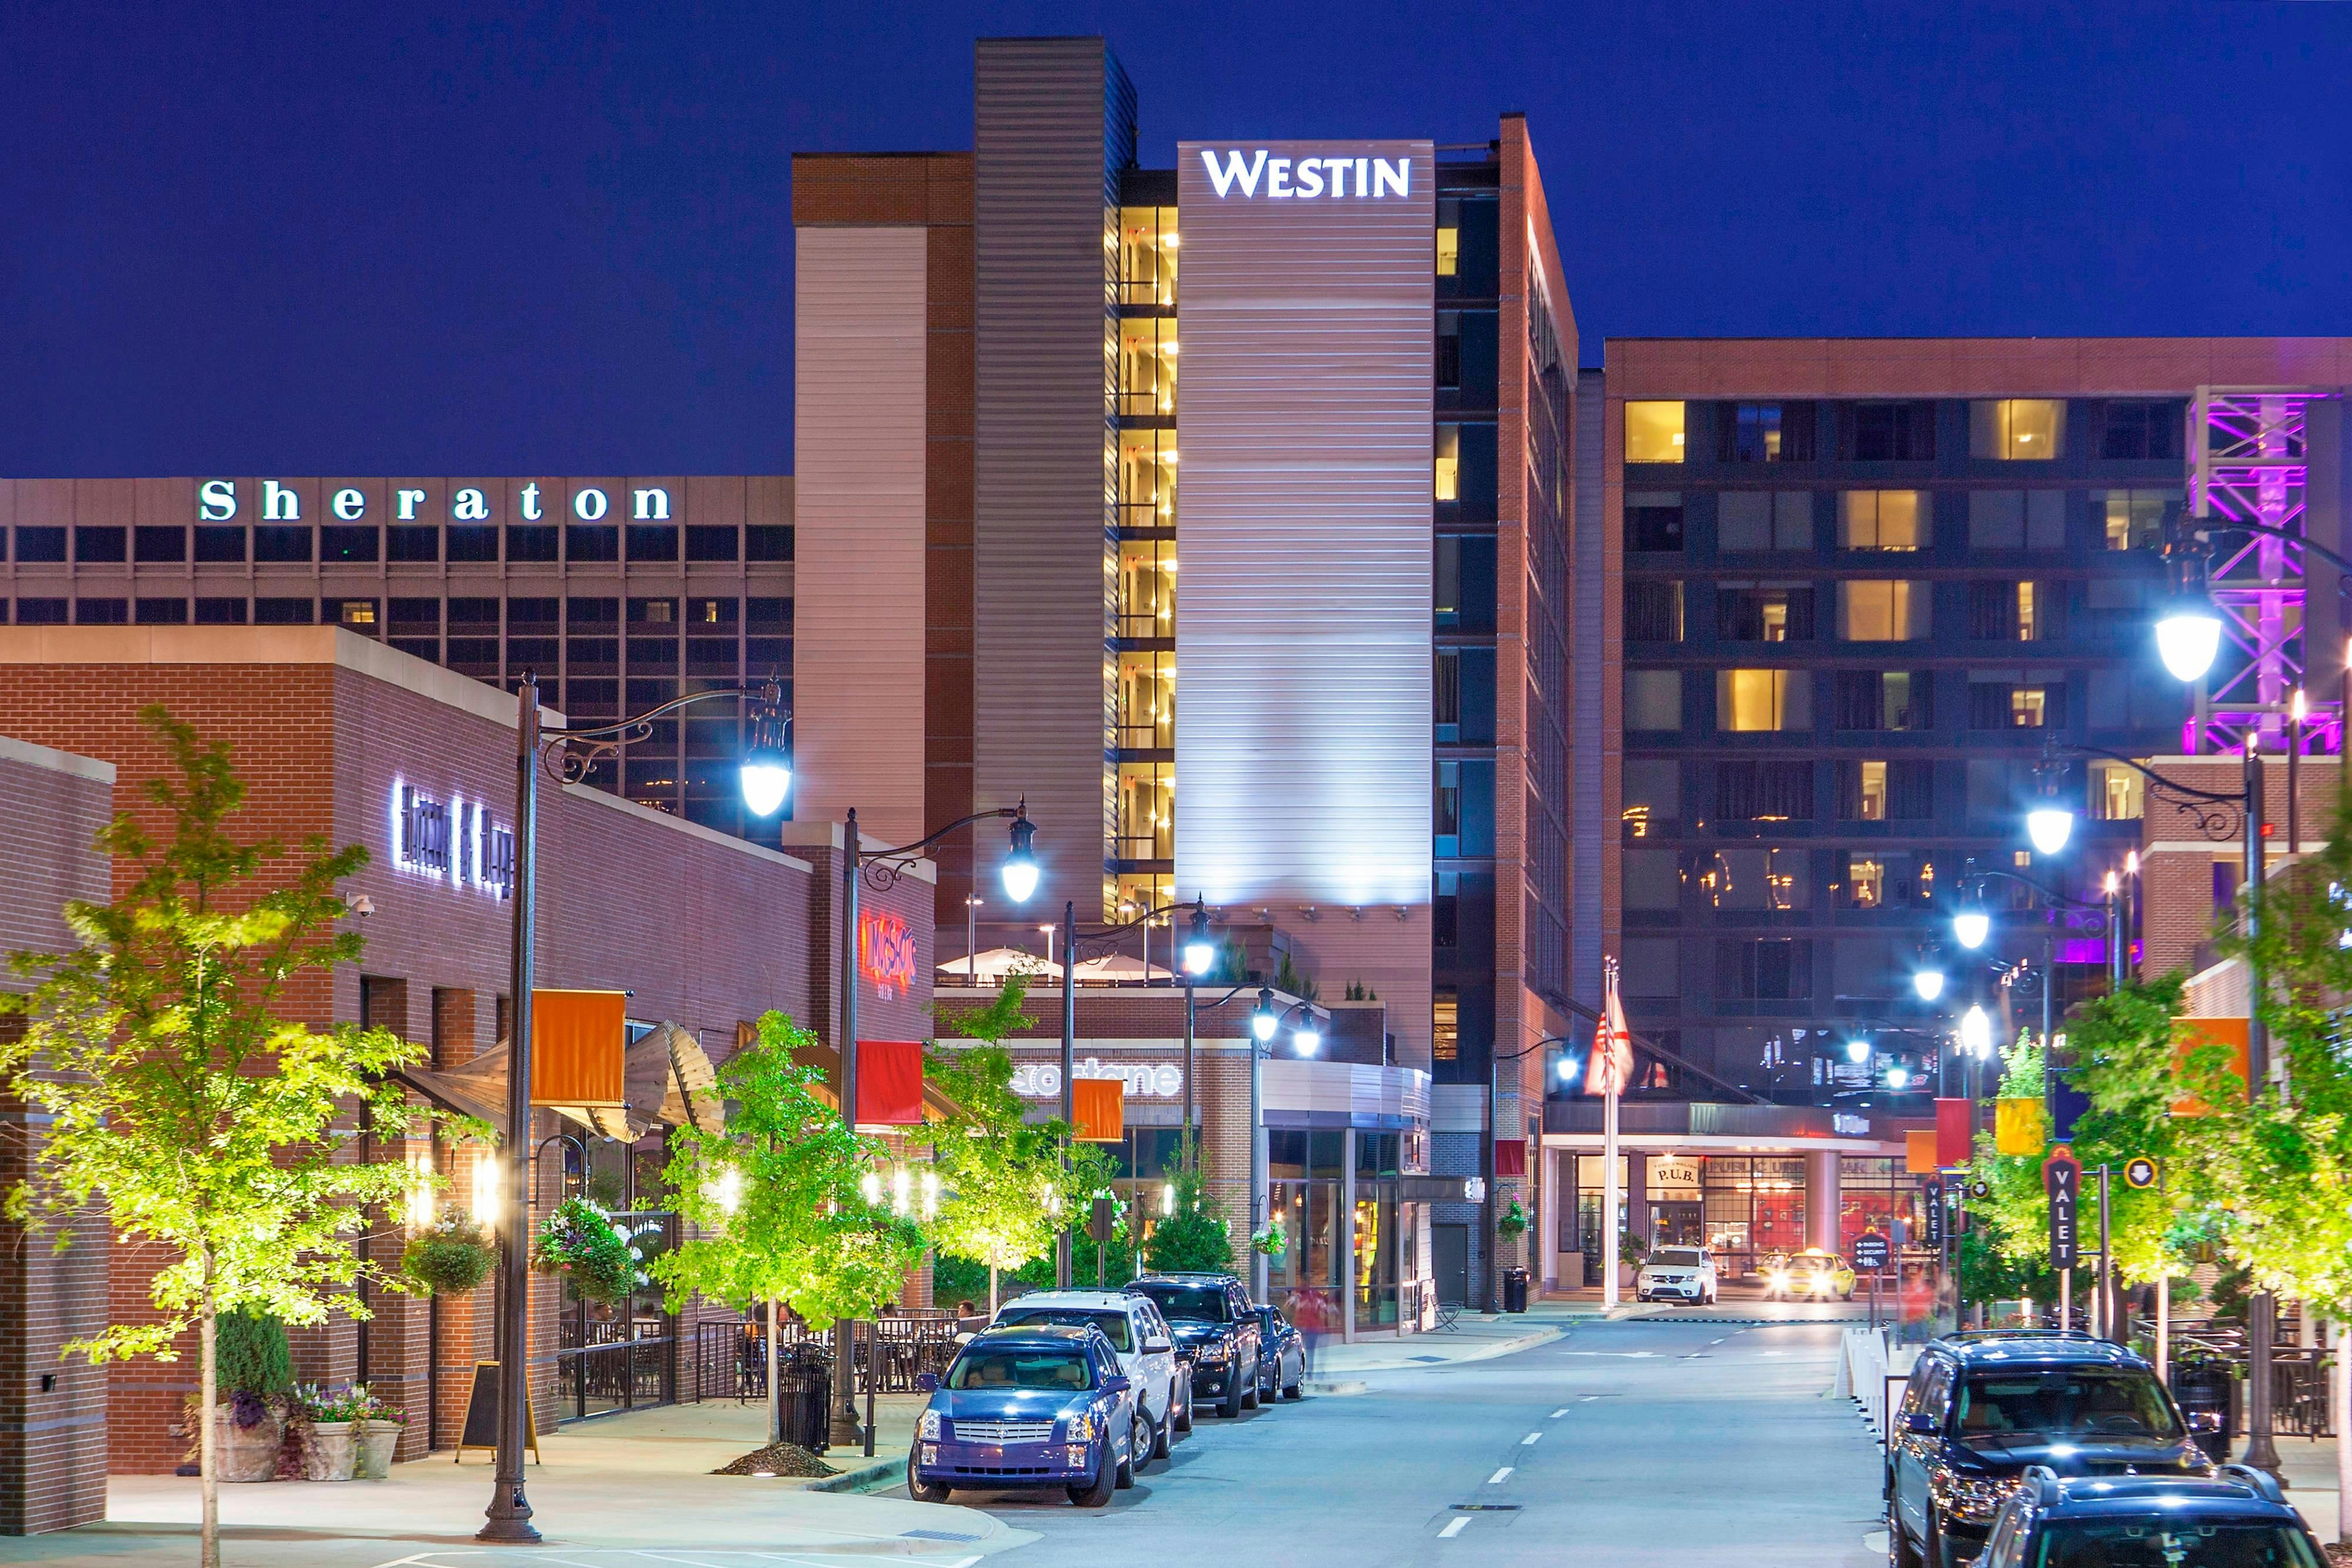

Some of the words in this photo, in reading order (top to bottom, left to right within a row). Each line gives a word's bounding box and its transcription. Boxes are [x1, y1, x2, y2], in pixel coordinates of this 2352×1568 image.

[1200, 149, 1411, 199] WESTIN
[200, 479, 671, 521] Sheraton
[1034, 1059, 1181, 1095] otne
[1658, 1169, 1694, 1182] P.U.B.
[1710, 1161, 1767, 1173] PUBLC
[1929, 1187, 1939, 1241] VALET
[2054, 1171, 2070, 1259] VALET
